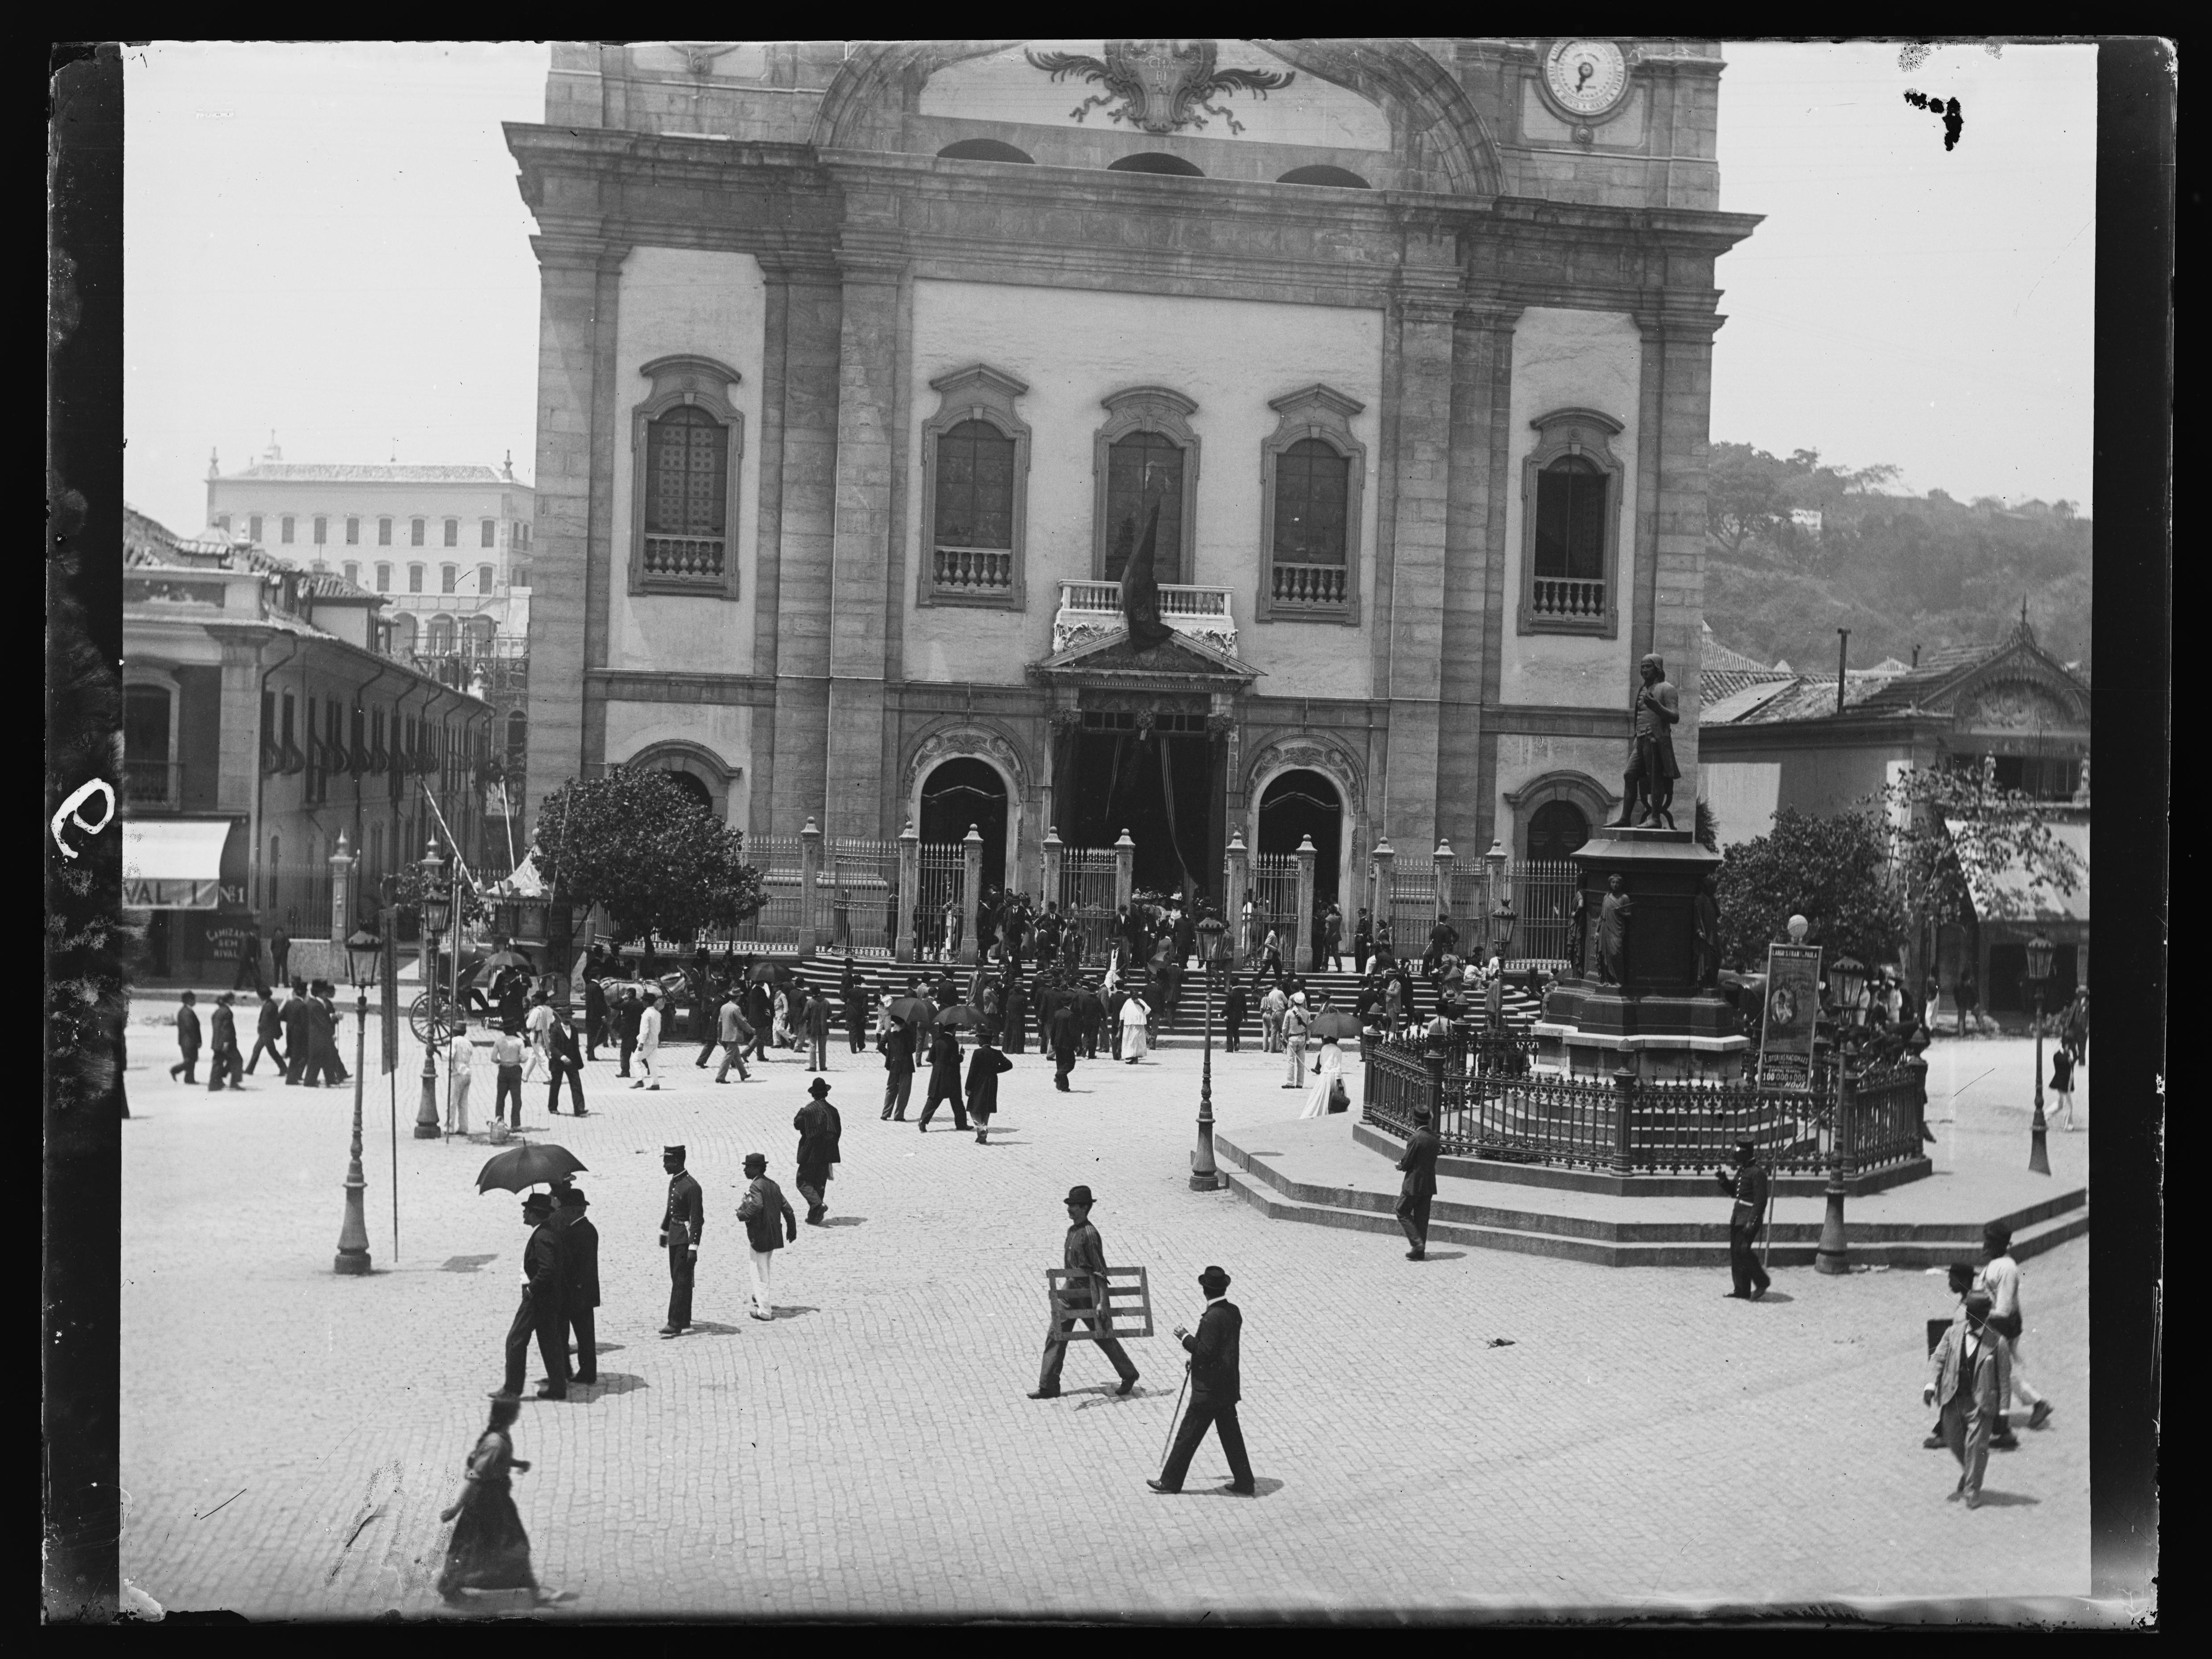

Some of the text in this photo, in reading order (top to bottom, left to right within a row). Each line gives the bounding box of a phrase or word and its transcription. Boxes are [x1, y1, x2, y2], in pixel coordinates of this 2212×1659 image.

[1149, 58, 1174, 69] CHA
[1157, 70, 1166, 81] RI
[218, 939, 238, 947] SEM
[214, 949, 239, 959] RIVAL
[1804, 951, 1817, 959] PAULA
[1763, 1053, 1785, 1063] LOTERIAS
